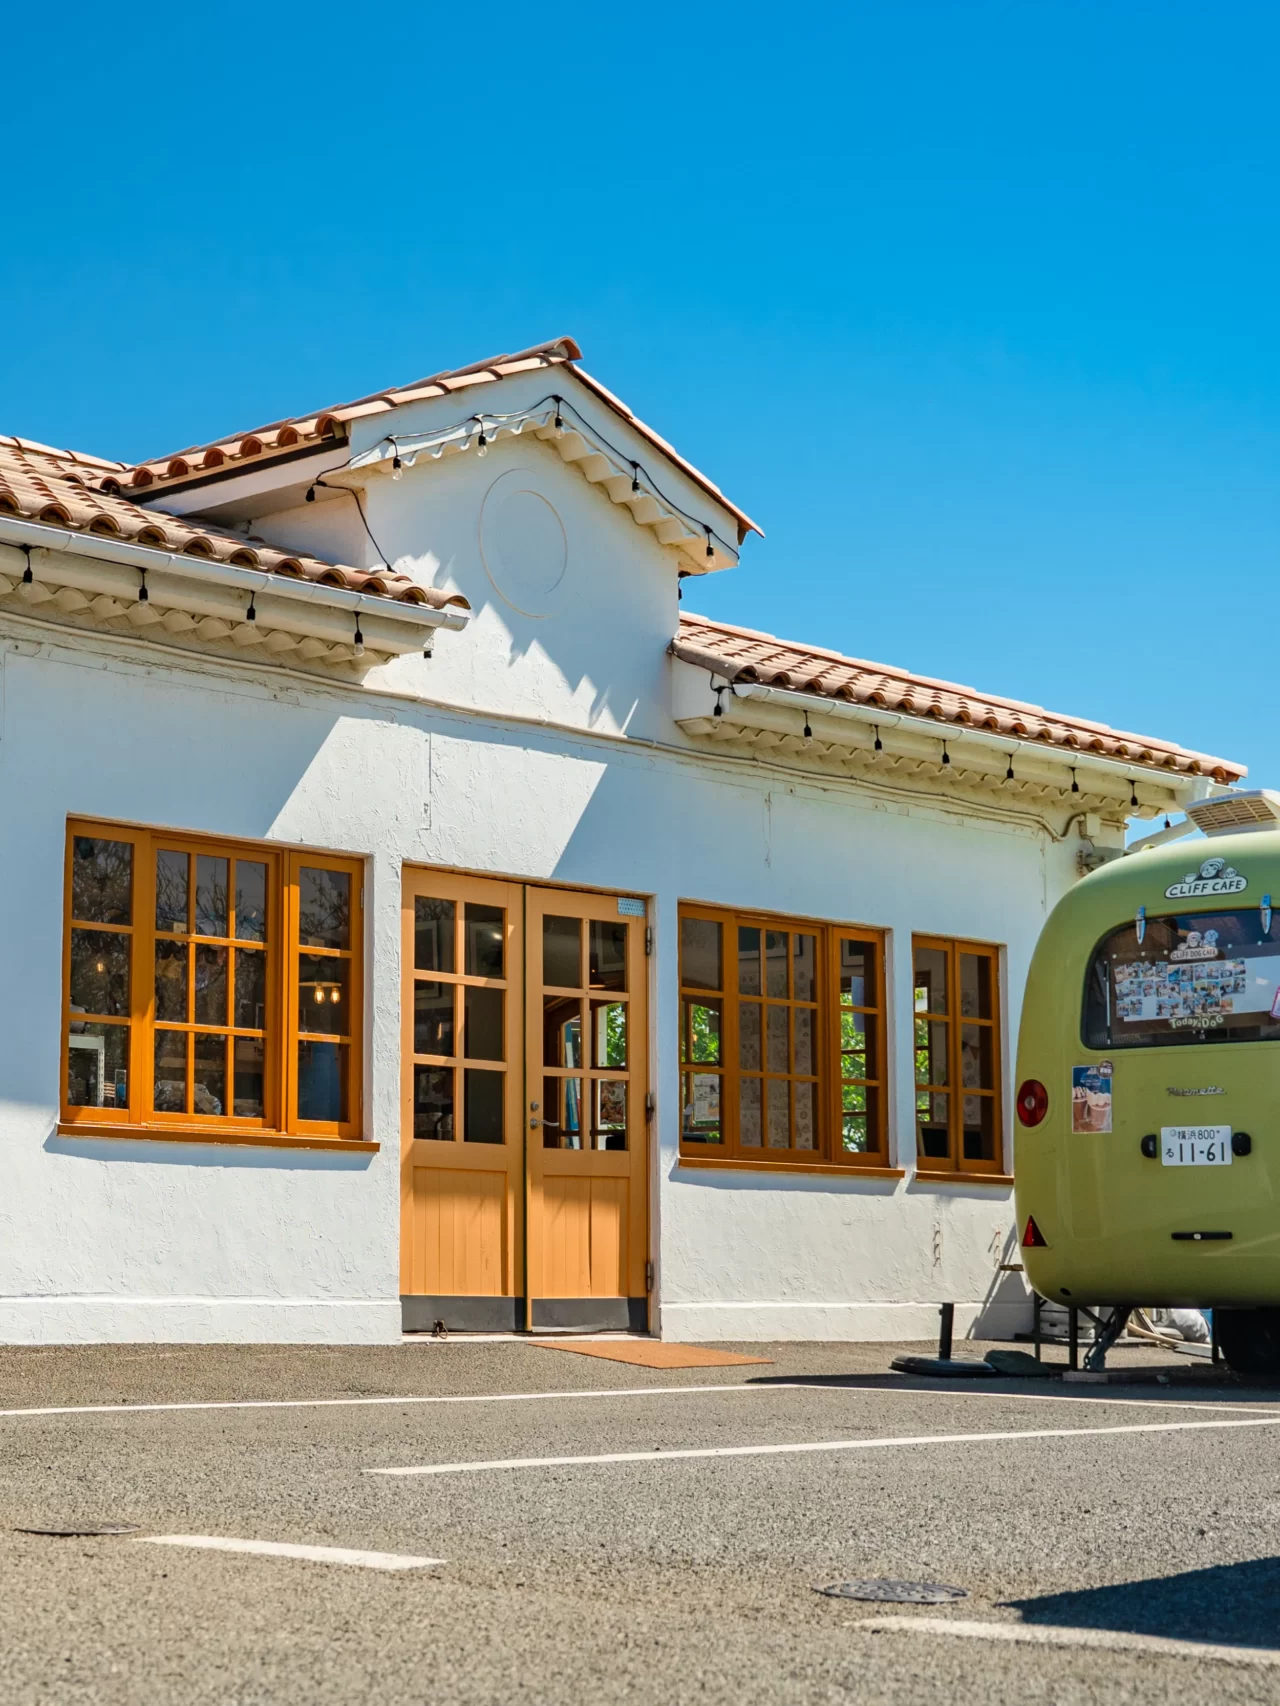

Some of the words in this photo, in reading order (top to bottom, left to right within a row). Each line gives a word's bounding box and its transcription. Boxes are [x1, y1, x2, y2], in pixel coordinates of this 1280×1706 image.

[1169, 883, 1209, 896] CLIFF
[1212, 879, 1242, 892] CAFE
[1171, 951, 1189, 960] CLIFF
[1190, 950, 1202, 958] DOG
[1203, 948, 1216, 956] CAFE
[1179, 1142, 1225, 1163] 11-61
